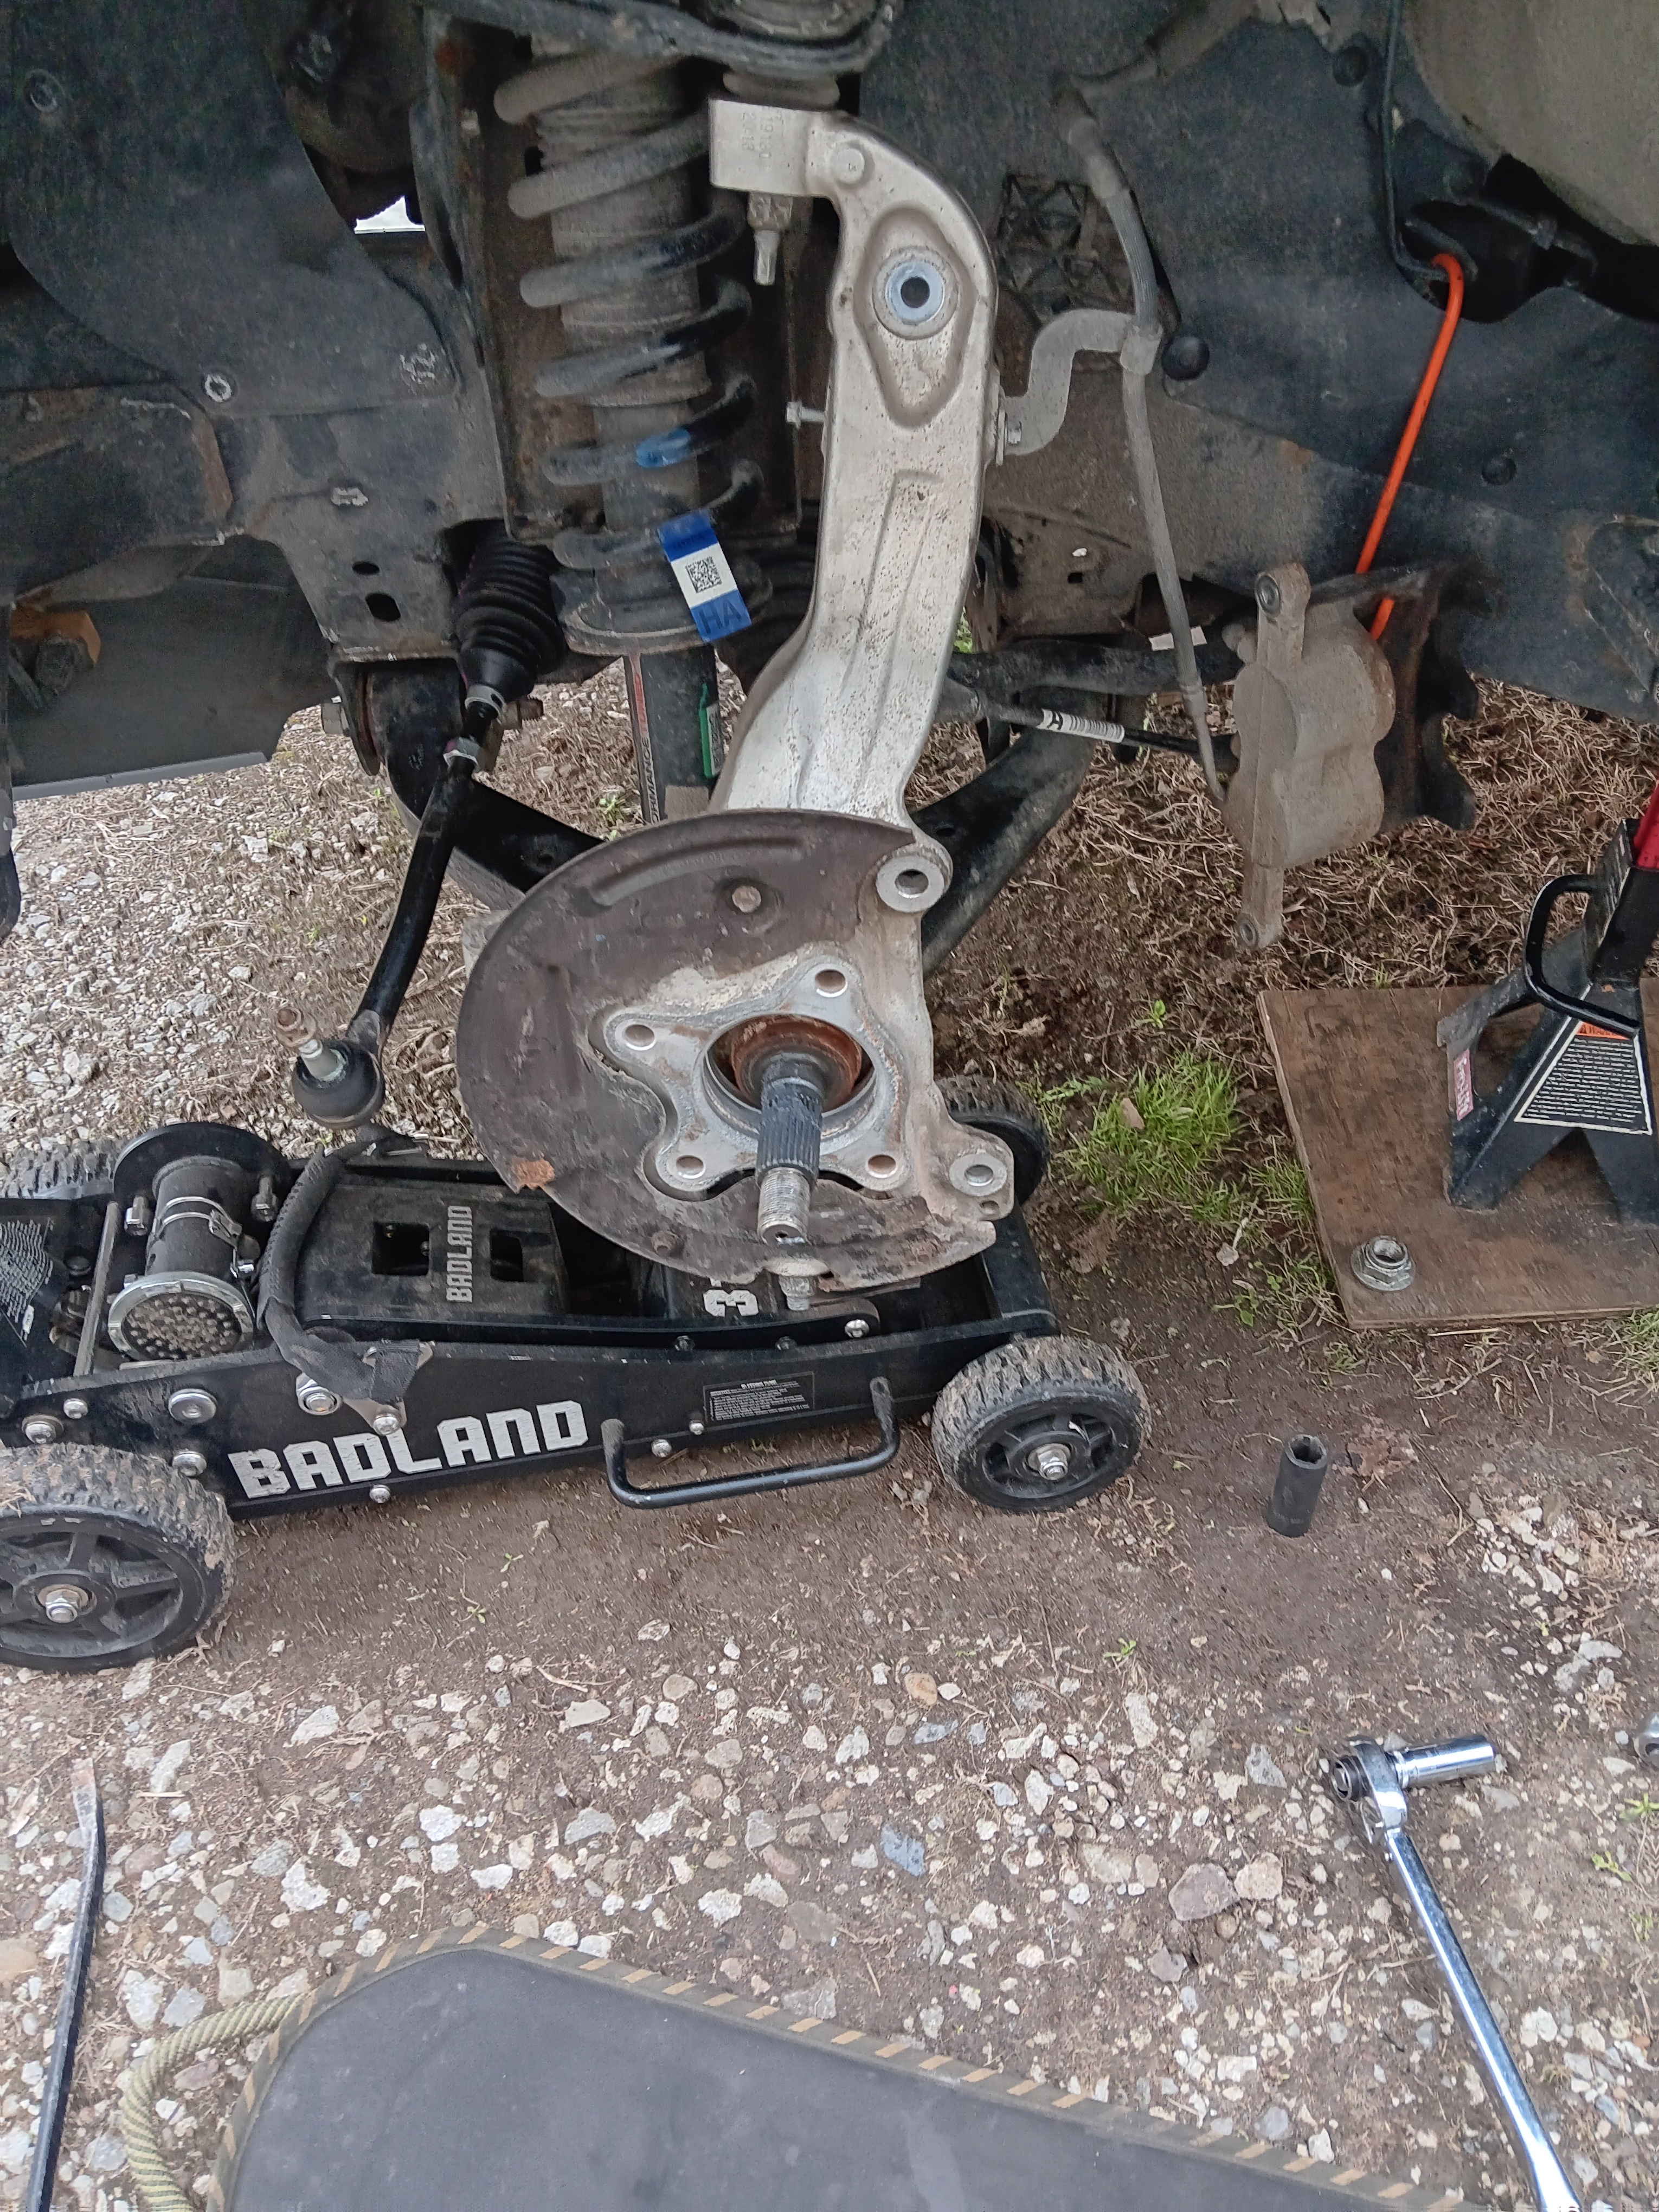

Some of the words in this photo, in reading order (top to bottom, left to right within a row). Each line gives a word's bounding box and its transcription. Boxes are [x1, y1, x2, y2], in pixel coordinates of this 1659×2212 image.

[698, 599, 742, 634] HA
[446, 1205, 473, 1303] BADLAND
[227, 1400, 589, 1499] BADLAND
